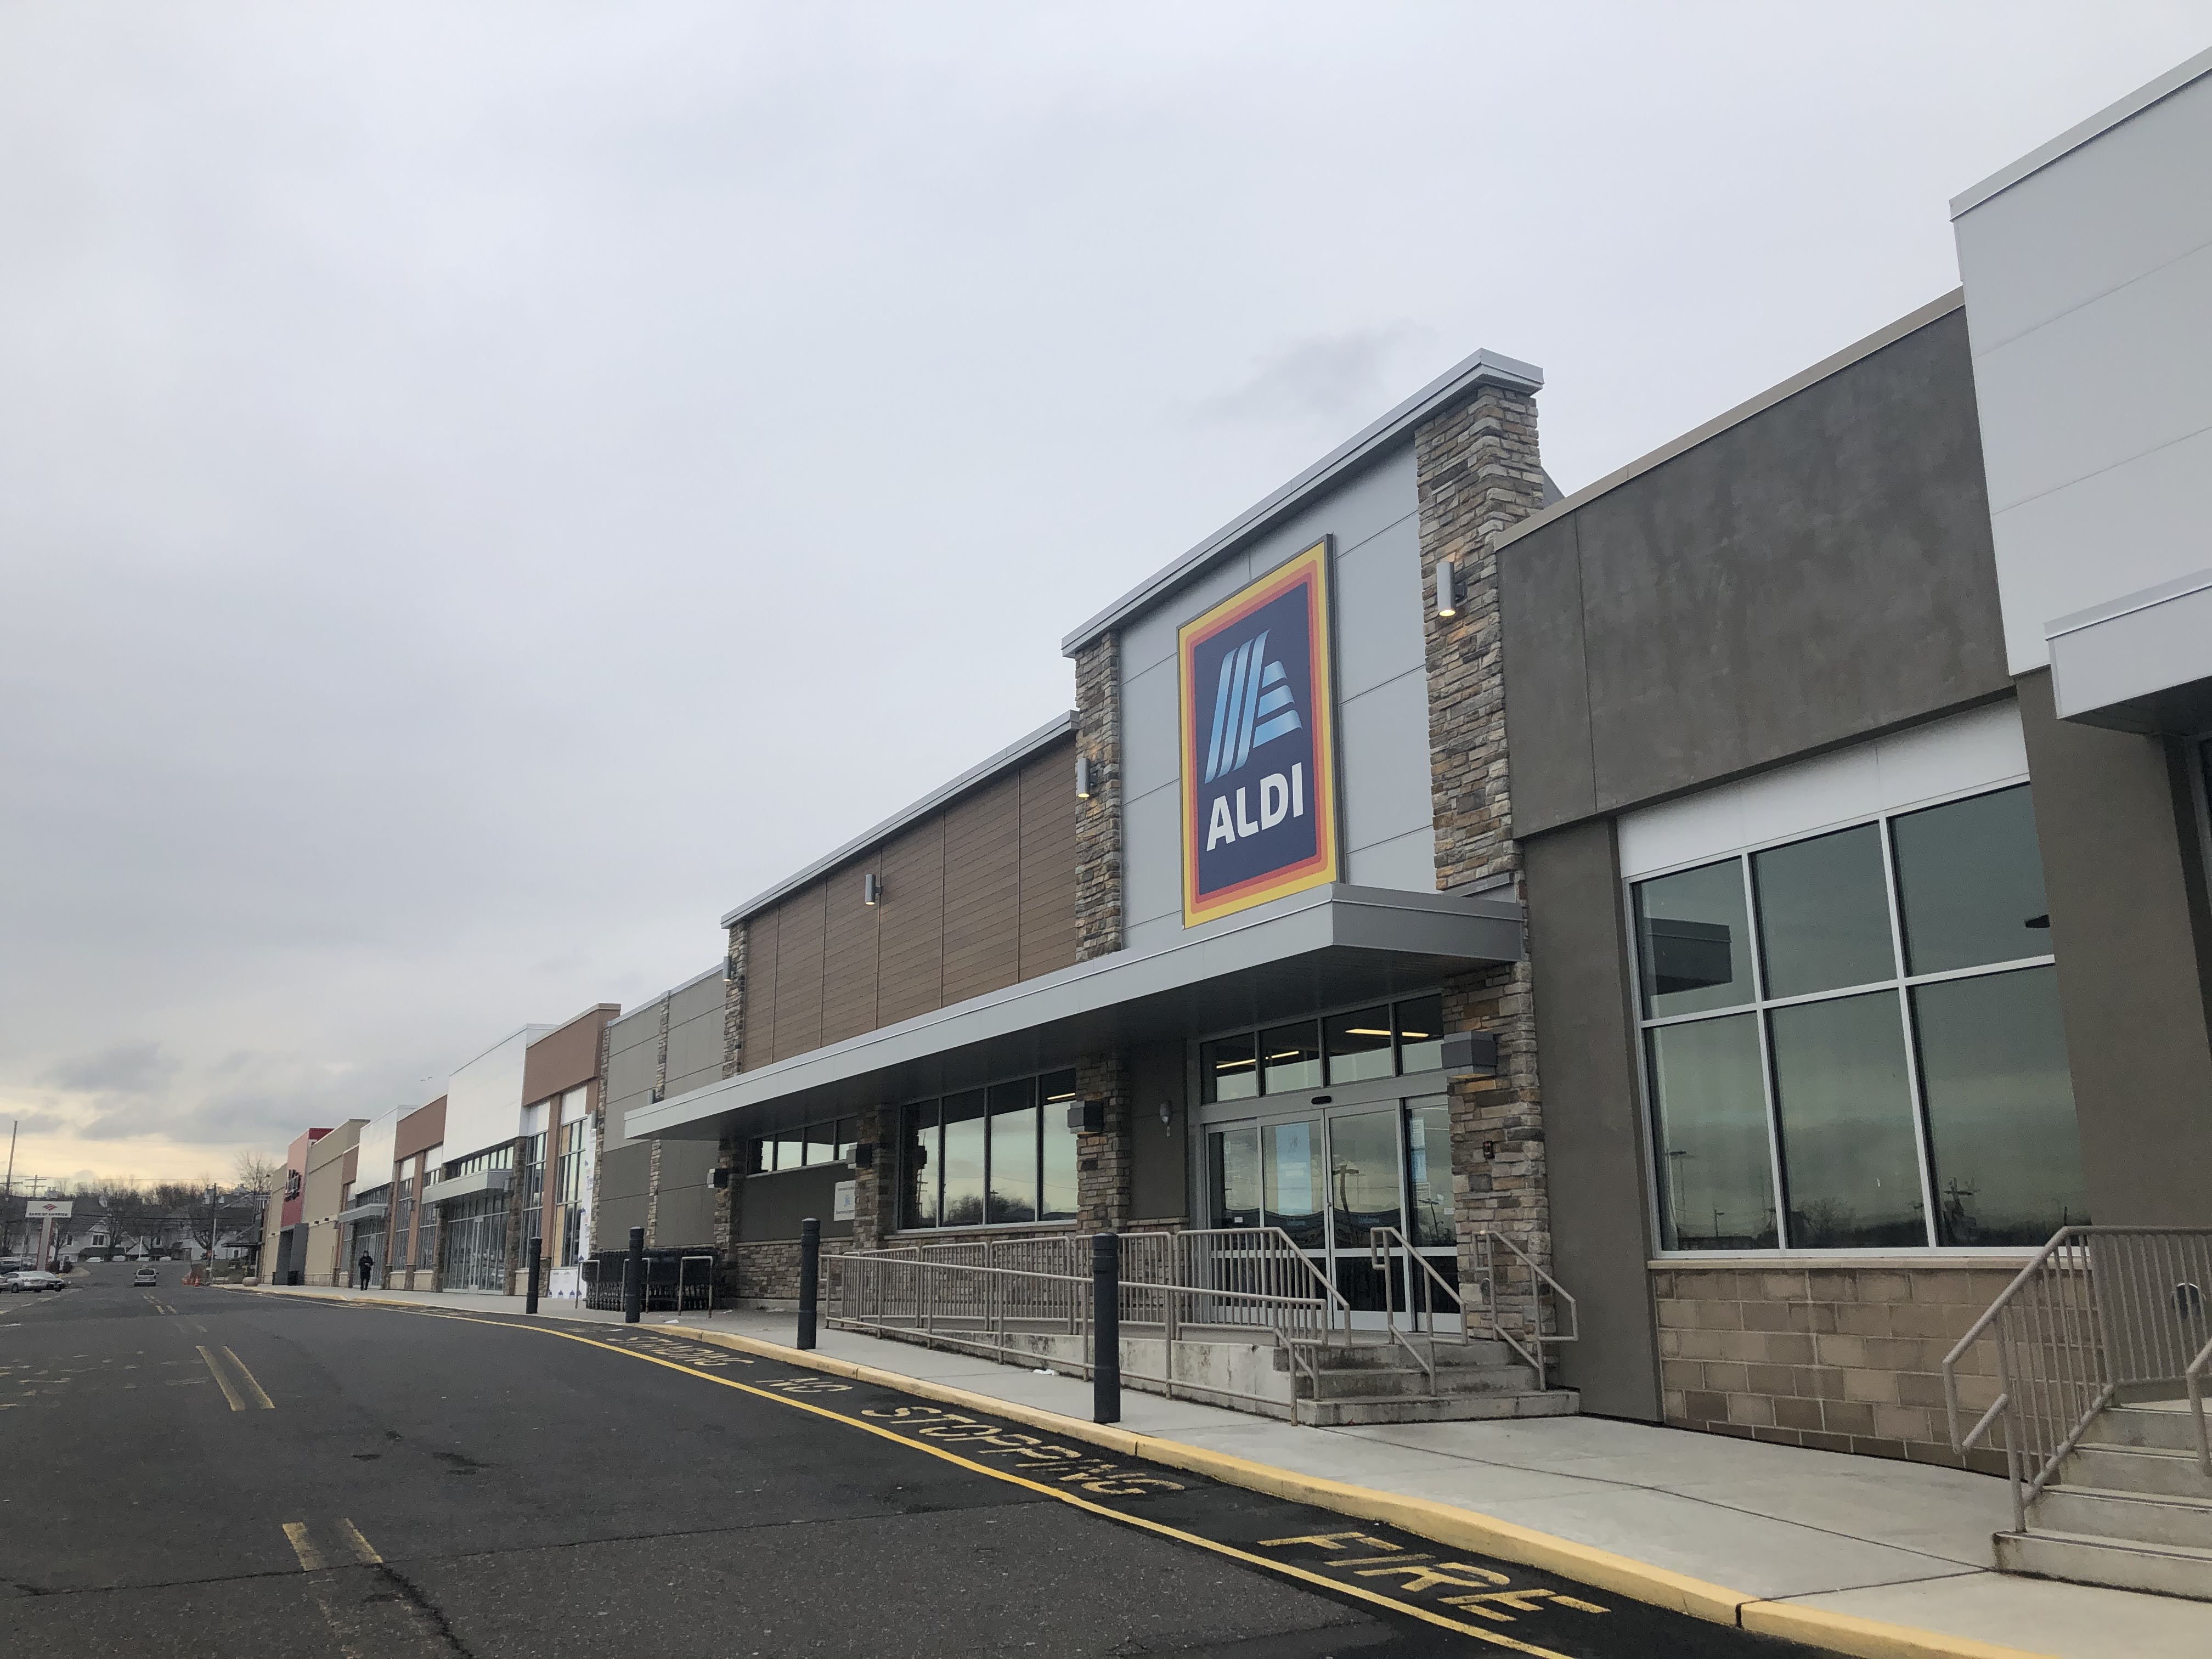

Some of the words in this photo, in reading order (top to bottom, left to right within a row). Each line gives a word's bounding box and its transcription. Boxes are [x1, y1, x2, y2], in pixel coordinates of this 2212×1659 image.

[1206, 762, 1304, 851] ALDI
[755, 1378, 853, 1393] NO
[861, 1406, 1186, 1494] STOPPING
[1256, 1532, 1612, 1622] FIRE
